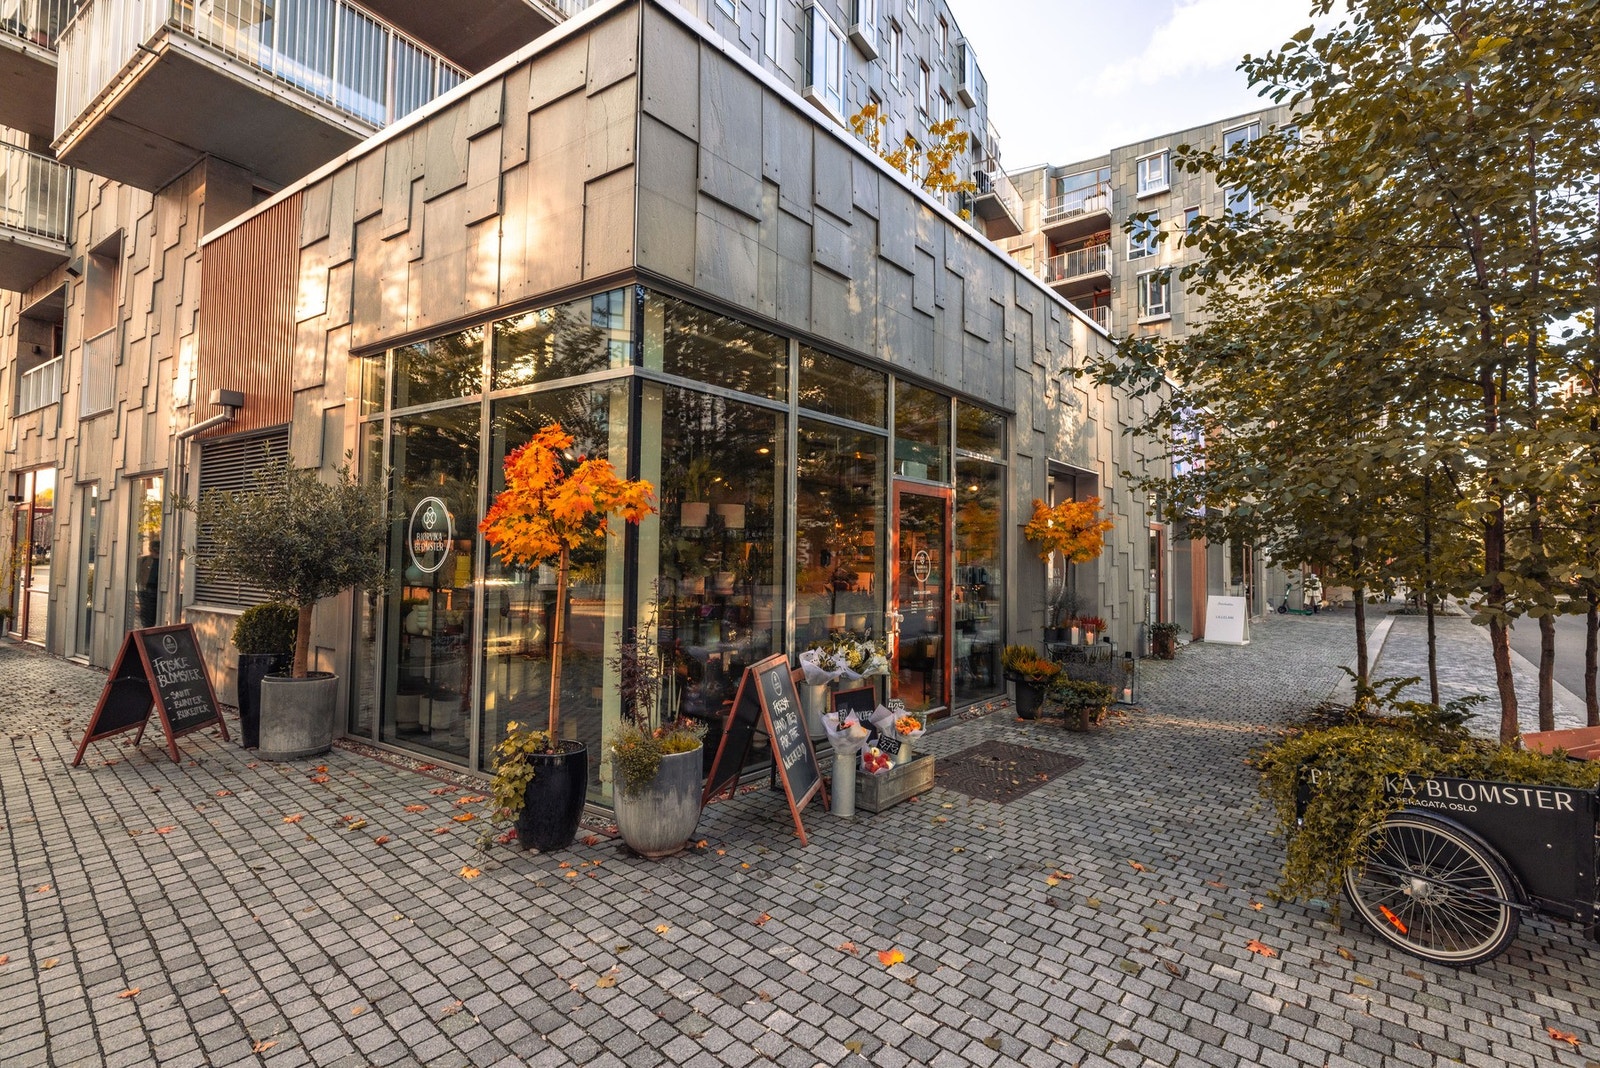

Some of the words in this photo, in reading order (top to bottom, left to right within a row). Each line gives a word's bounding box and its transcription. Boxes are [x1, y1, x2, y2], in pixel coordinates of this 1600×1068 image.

[414, 542, 444, 552] BLOMSTER
[152, 656, 191, 675] FRISKE
[156, 668, 204, 688] BLOMSTER
[772, 696, 790, 717] FRESH
[1426, 779, 1575, 812] BLOMSTER
[1448, 803, 1478, 813] OSLO
